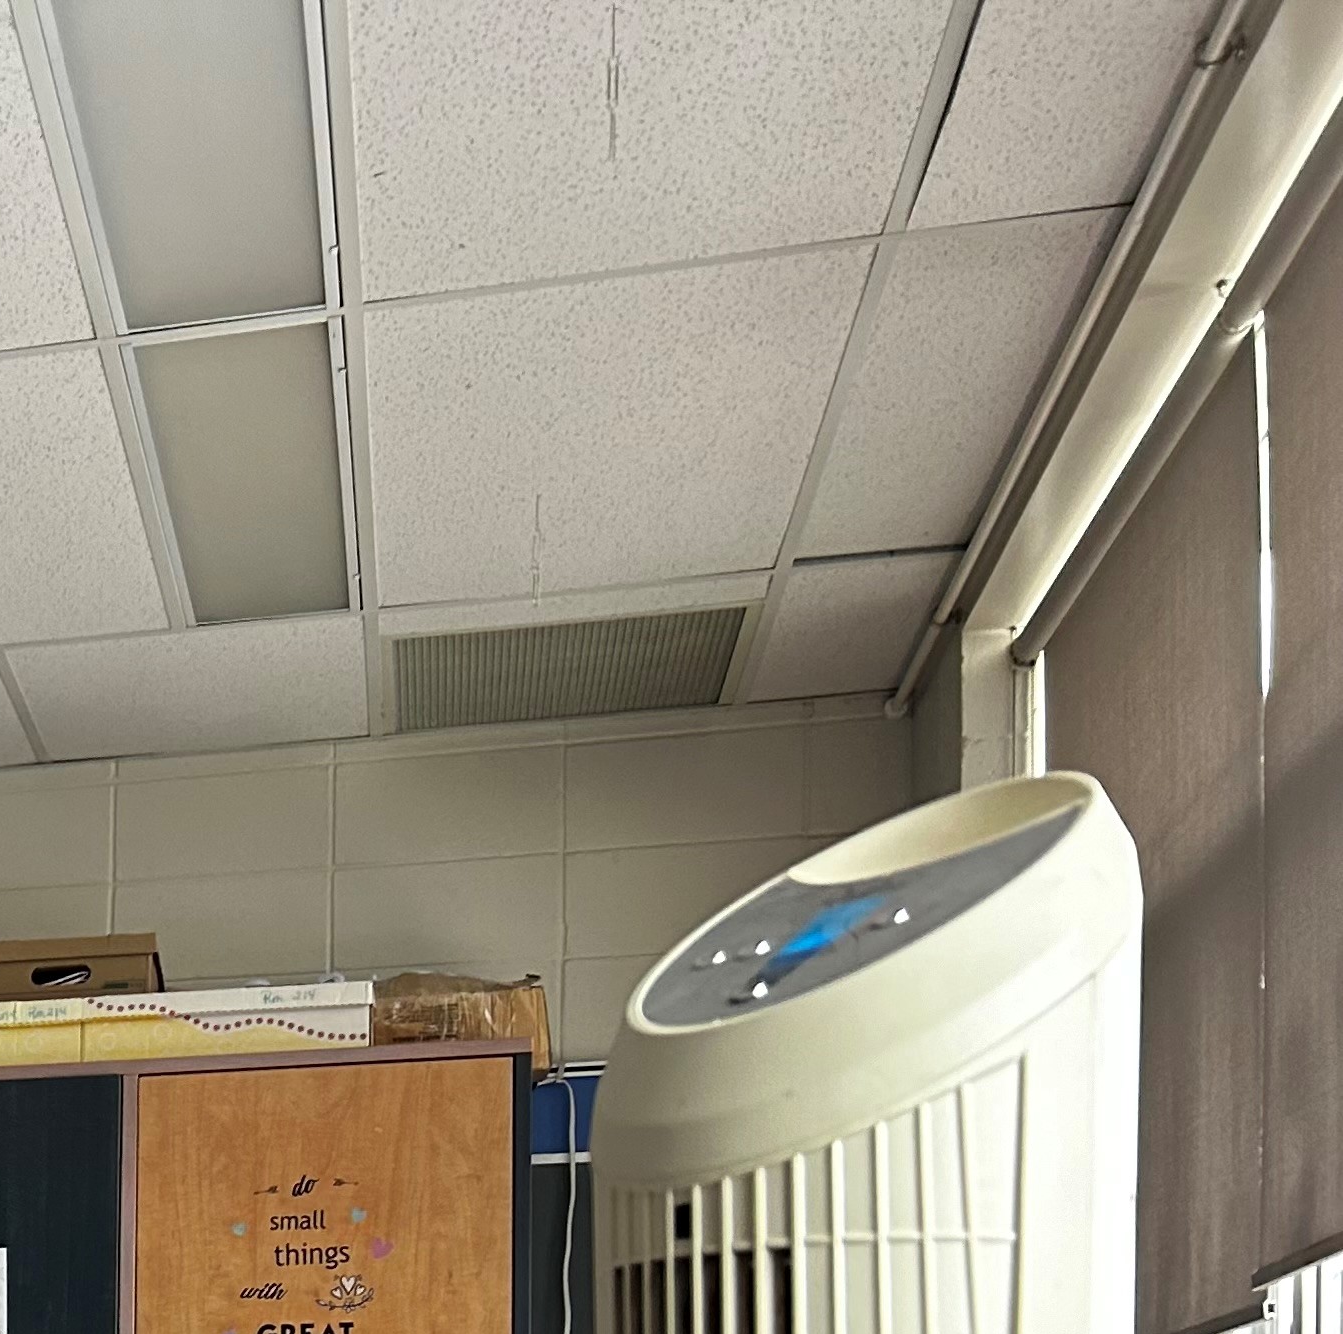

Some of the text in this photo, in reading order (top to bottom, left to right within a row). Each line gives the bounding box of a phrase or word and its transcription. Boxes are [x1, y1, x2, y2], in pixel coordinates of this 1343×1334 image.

[292, 1174, 319, 1197] do
[269, 1209, 327, 1231] small
[274, 1243, 351, 1270] things
[240, 1283, 290, 1301] with
